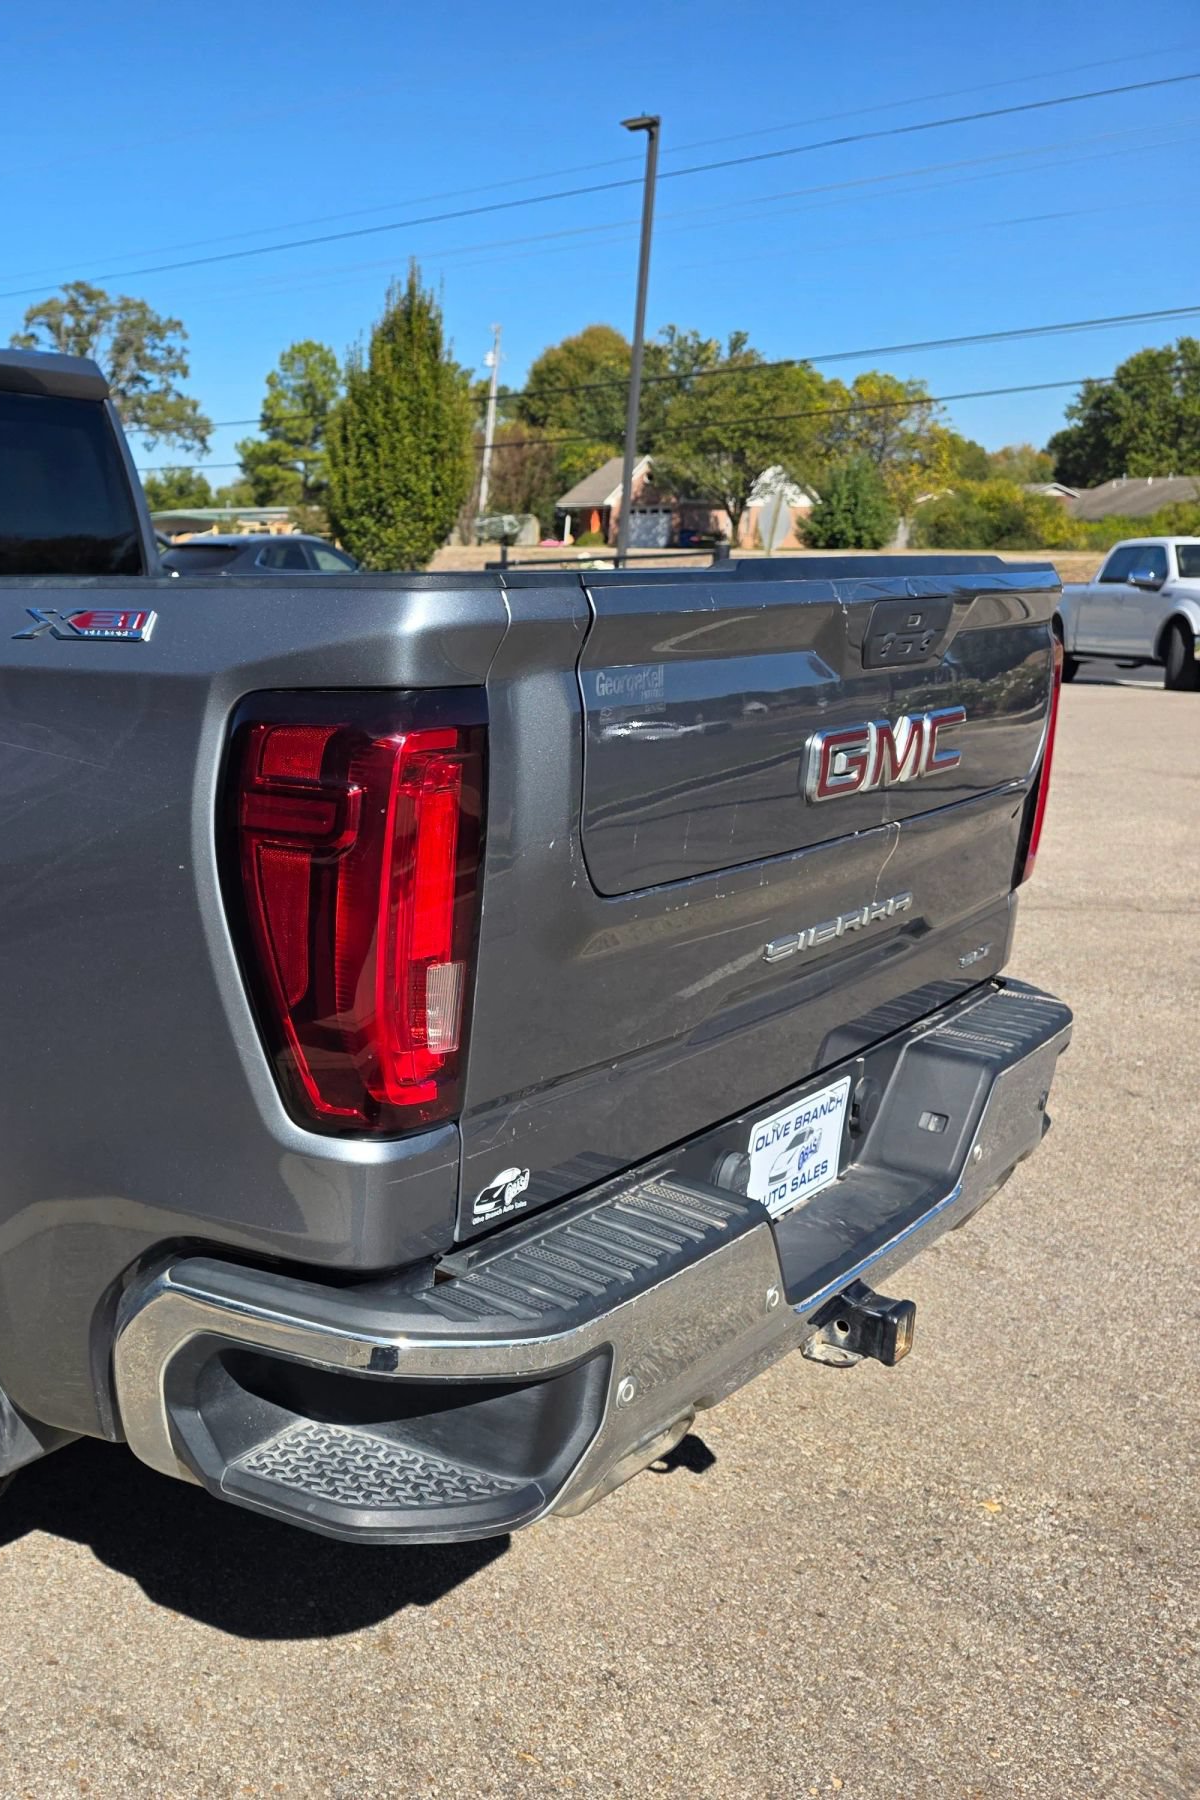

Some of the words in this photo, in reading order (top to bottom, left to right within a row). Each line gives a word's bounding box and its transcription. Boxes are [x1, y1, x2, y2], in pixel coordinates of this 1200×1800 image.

[804, 705, 967, 803] GMC
[763, 891, 913, 964] SIERRA
[755, 1121, 792, 1153] OLIVE
[794, 1094, 843, 1131] BRANCH
[472, 1216, 485, 1225] Olive
[485, 1208, 502, 1220] Branch
[503, 1205, 514, 1213] Auto
[514, 1200, 527, 1209] Sales
[758, 1184, 787, 1208] UTO
[791, 1160, 829, 1193] SALES
